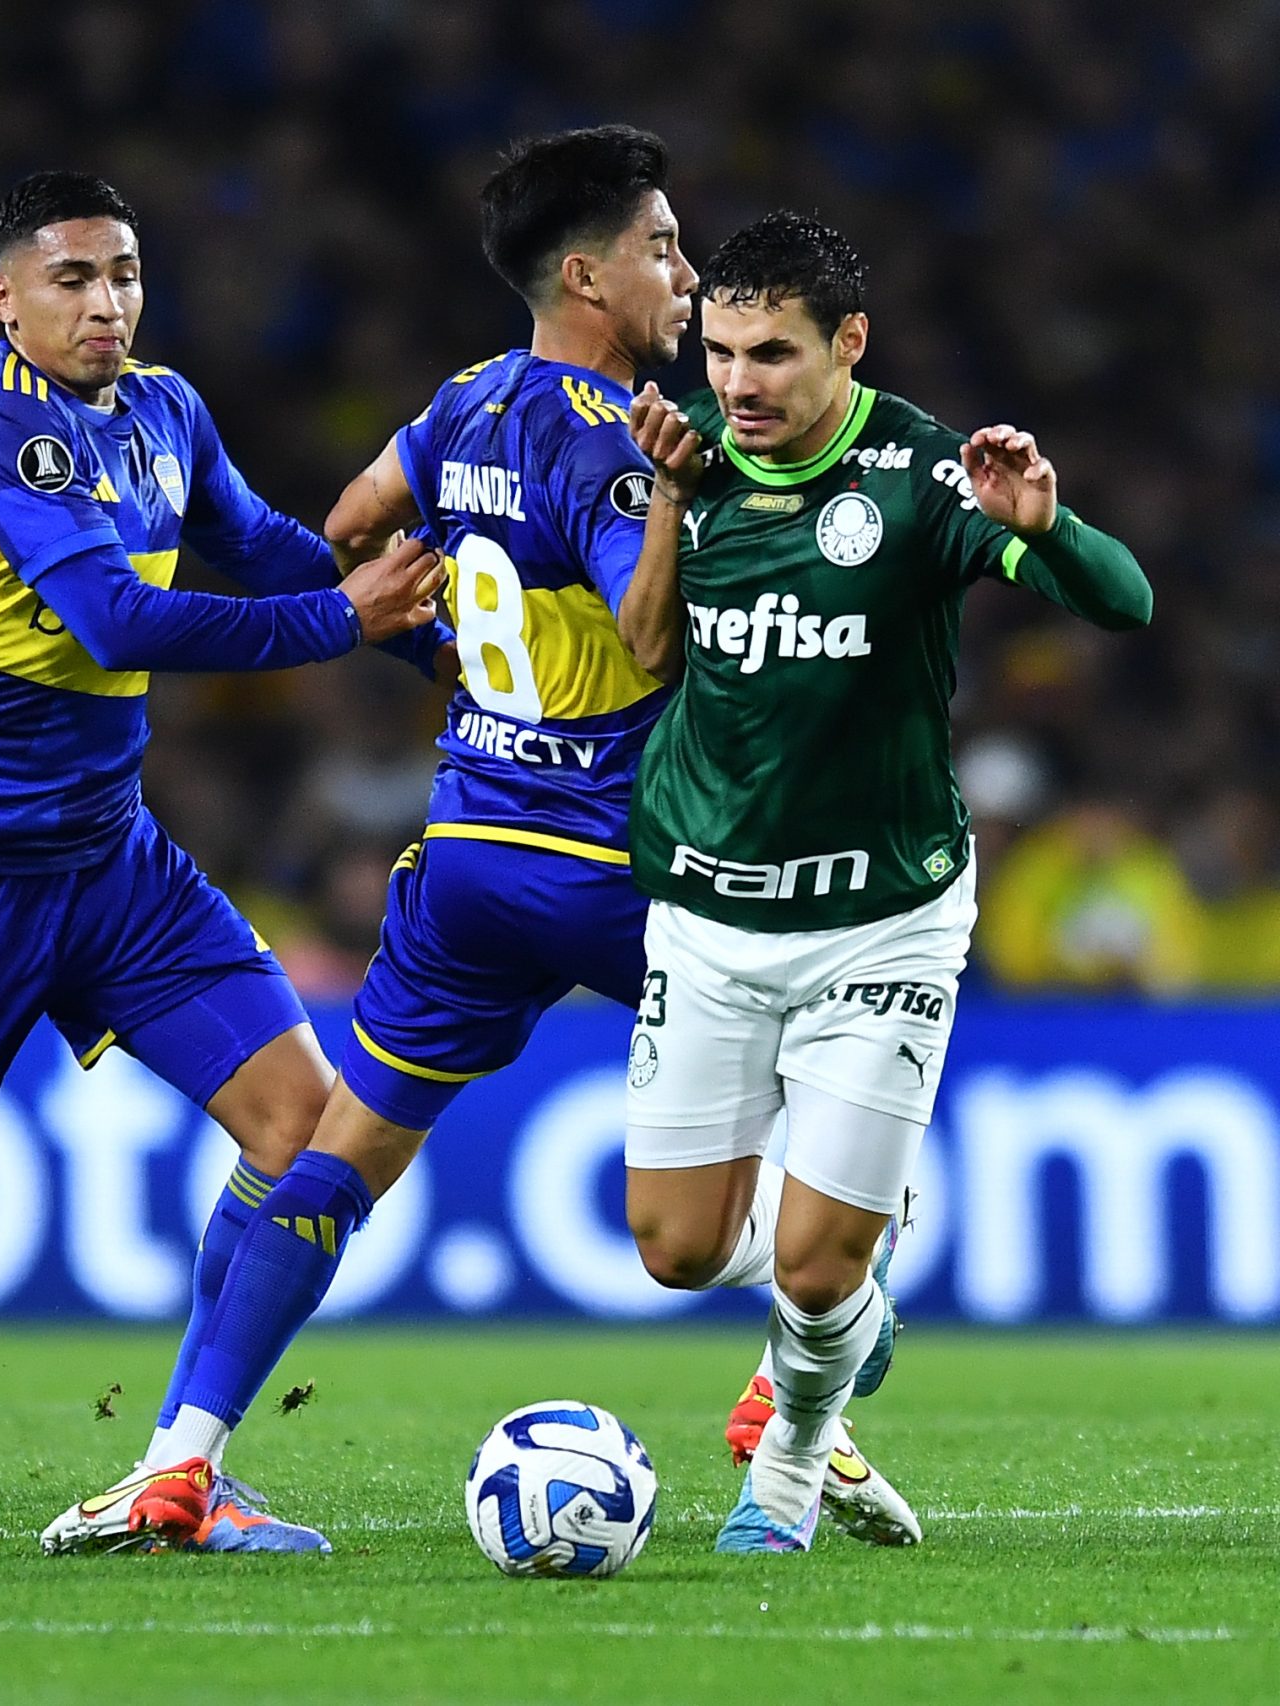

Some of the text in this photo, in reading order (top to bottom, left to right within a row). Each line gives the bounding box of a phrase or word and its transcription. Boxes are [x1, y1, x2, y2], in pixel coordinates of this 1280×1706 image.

[821, 522, 879, 562] PALMEIRAS
[456, 533, 543, 725] 8
[456, 712, 595, 769] DIRECTV
